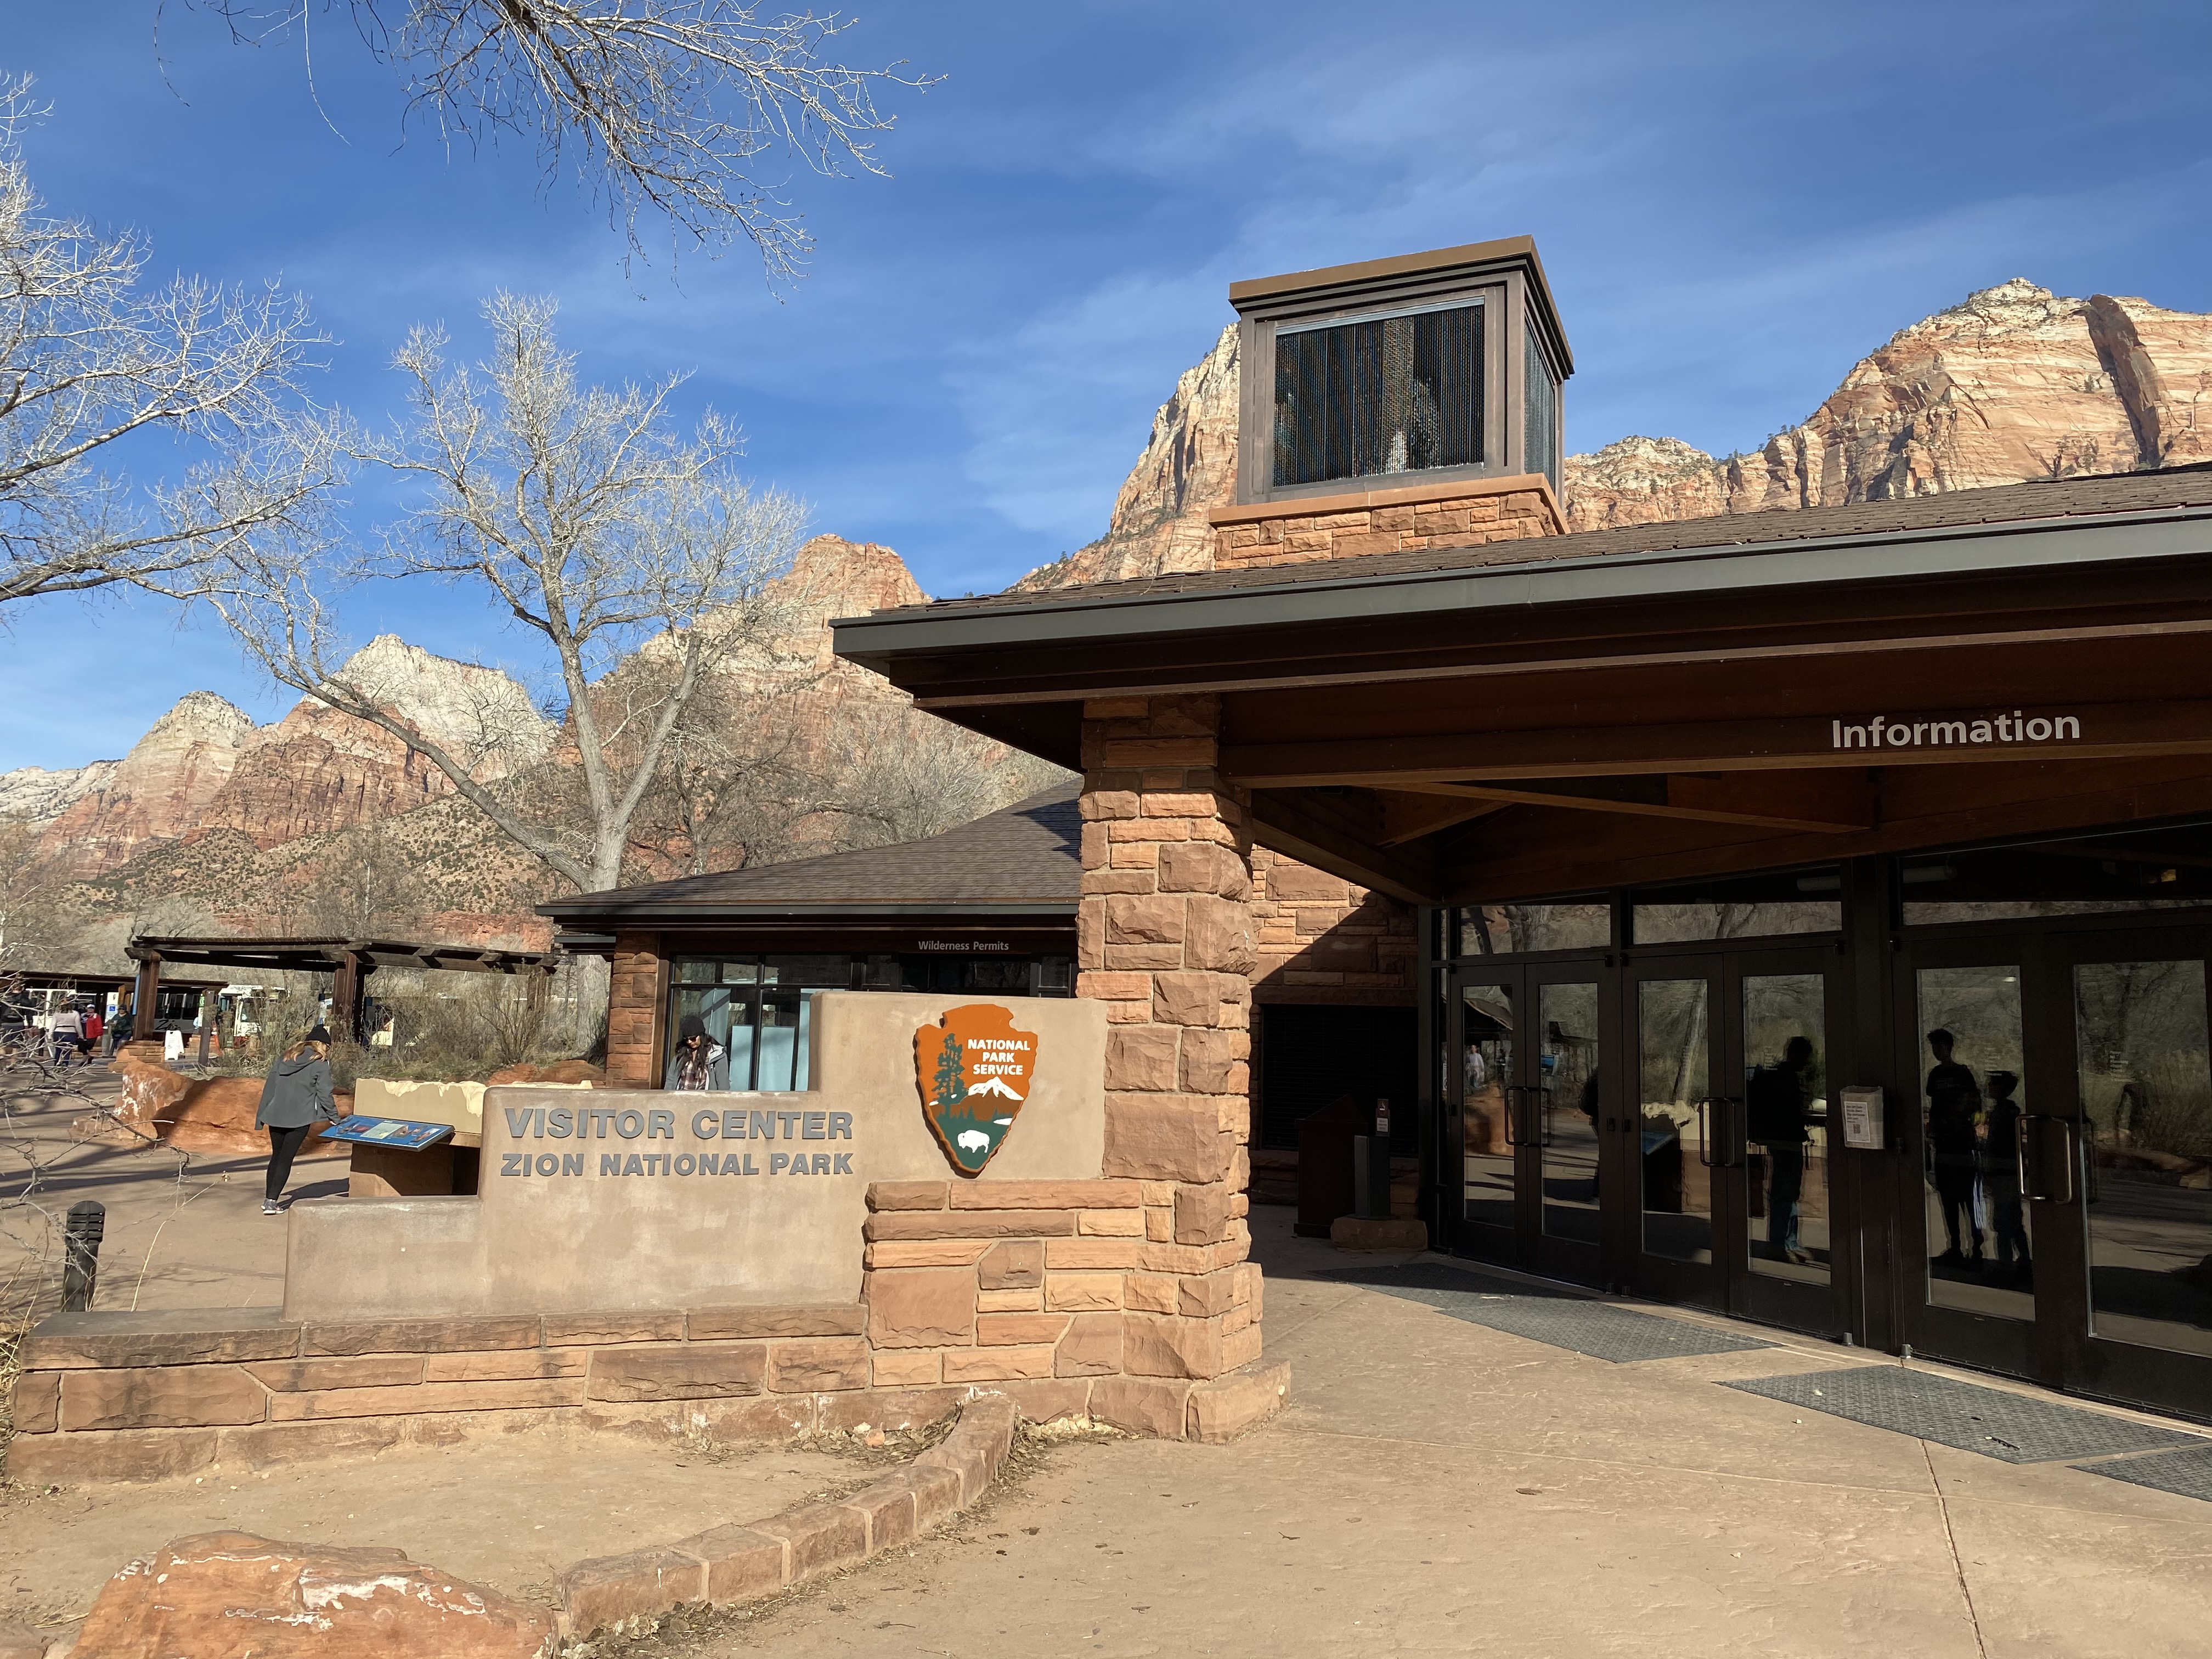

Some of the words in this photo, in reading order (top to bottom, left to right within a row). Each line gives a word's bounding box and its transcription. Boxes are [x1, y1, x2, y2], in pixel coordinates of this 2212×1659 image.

[1832, 710, 2080, 748] Information
[918, 940, 969, 950] Wilderness
[973, 941, 1009, 950] Permits
[967, 1039, 1031, 1051] NATIONAL
[982, 1052, 1015, 1063] PARK
[973, 1064, 1023, 1075] SERVICE
[505, 1108, 675, 1138] VISITOR
[692, 1109, 853, 1139] CENTER
[500, 1153, 584, 1177] ZION
[600, 1153, 759, 1176] NATIONAL
[770, 1153, 854, 1175] PARK
